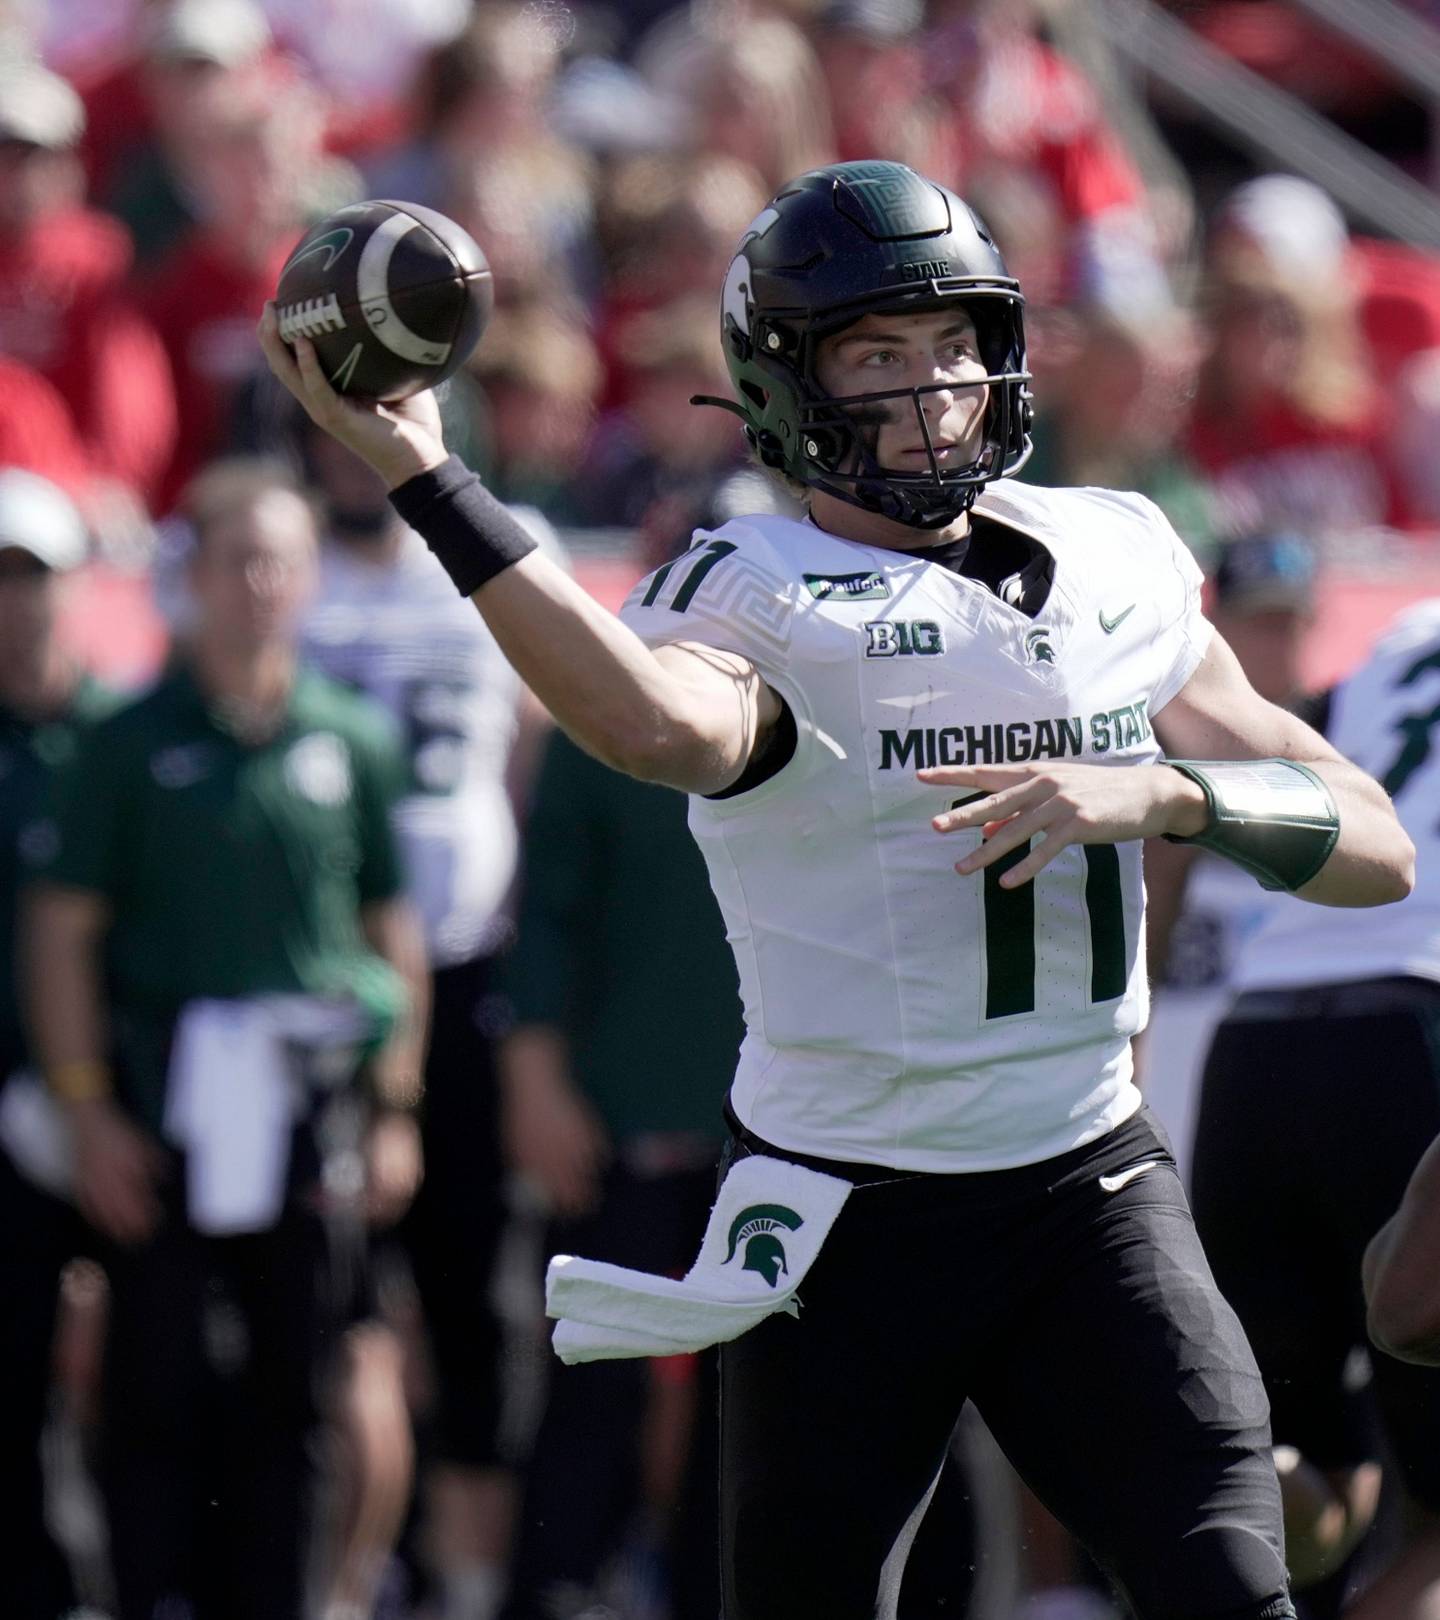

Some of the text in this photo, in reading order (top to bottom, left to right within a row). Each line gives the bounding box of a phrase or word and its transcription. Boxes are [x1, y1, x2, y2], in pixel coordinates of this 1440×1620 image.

[903, 260, 952, 280] STATE
[640, 539, 739, 614] 11
[878, 698, 1151, 770] MICHIGAN STAT
[951, 791, 1127, 1020] 11
